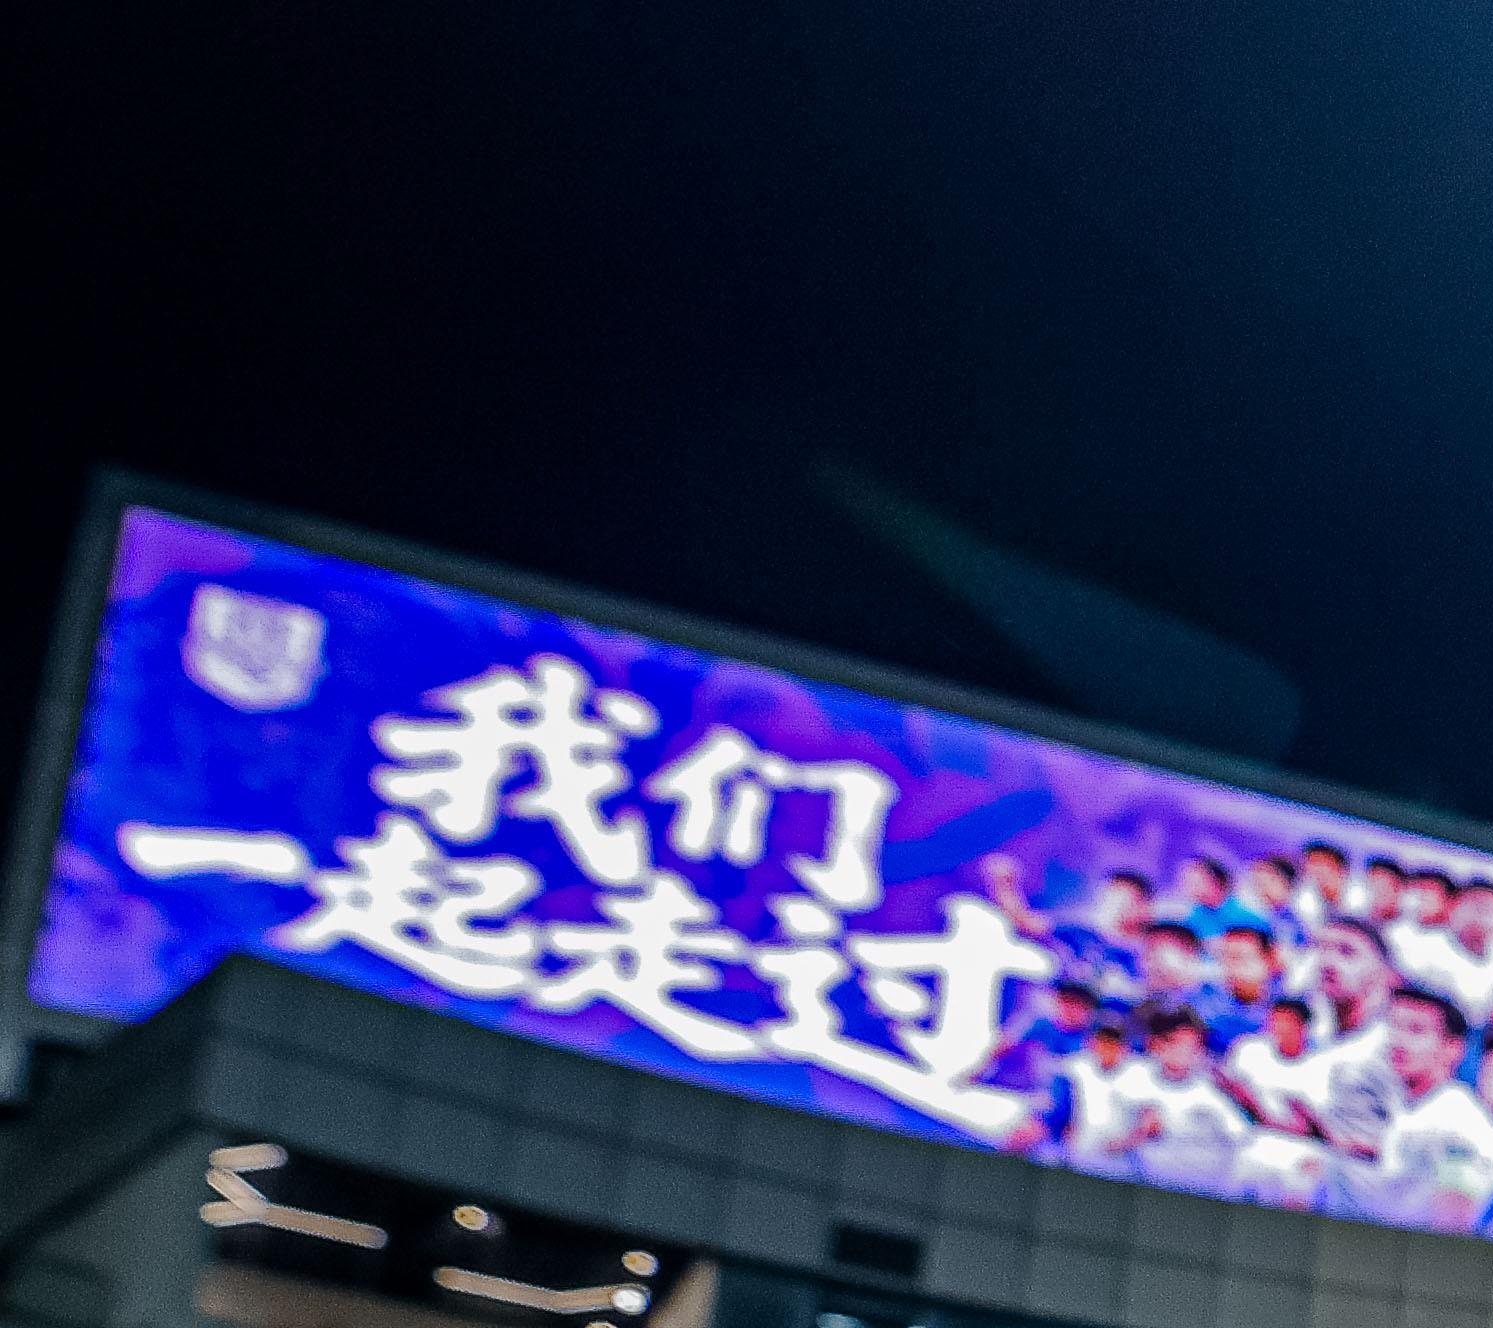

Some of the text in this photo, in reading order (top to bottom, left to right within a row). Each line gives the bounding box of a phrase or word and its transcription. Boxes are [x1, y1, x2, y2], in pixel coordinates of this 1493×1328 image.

[372, 655, 894, 911] 我们
[120, 822, 1049, 1131] 一起走过
